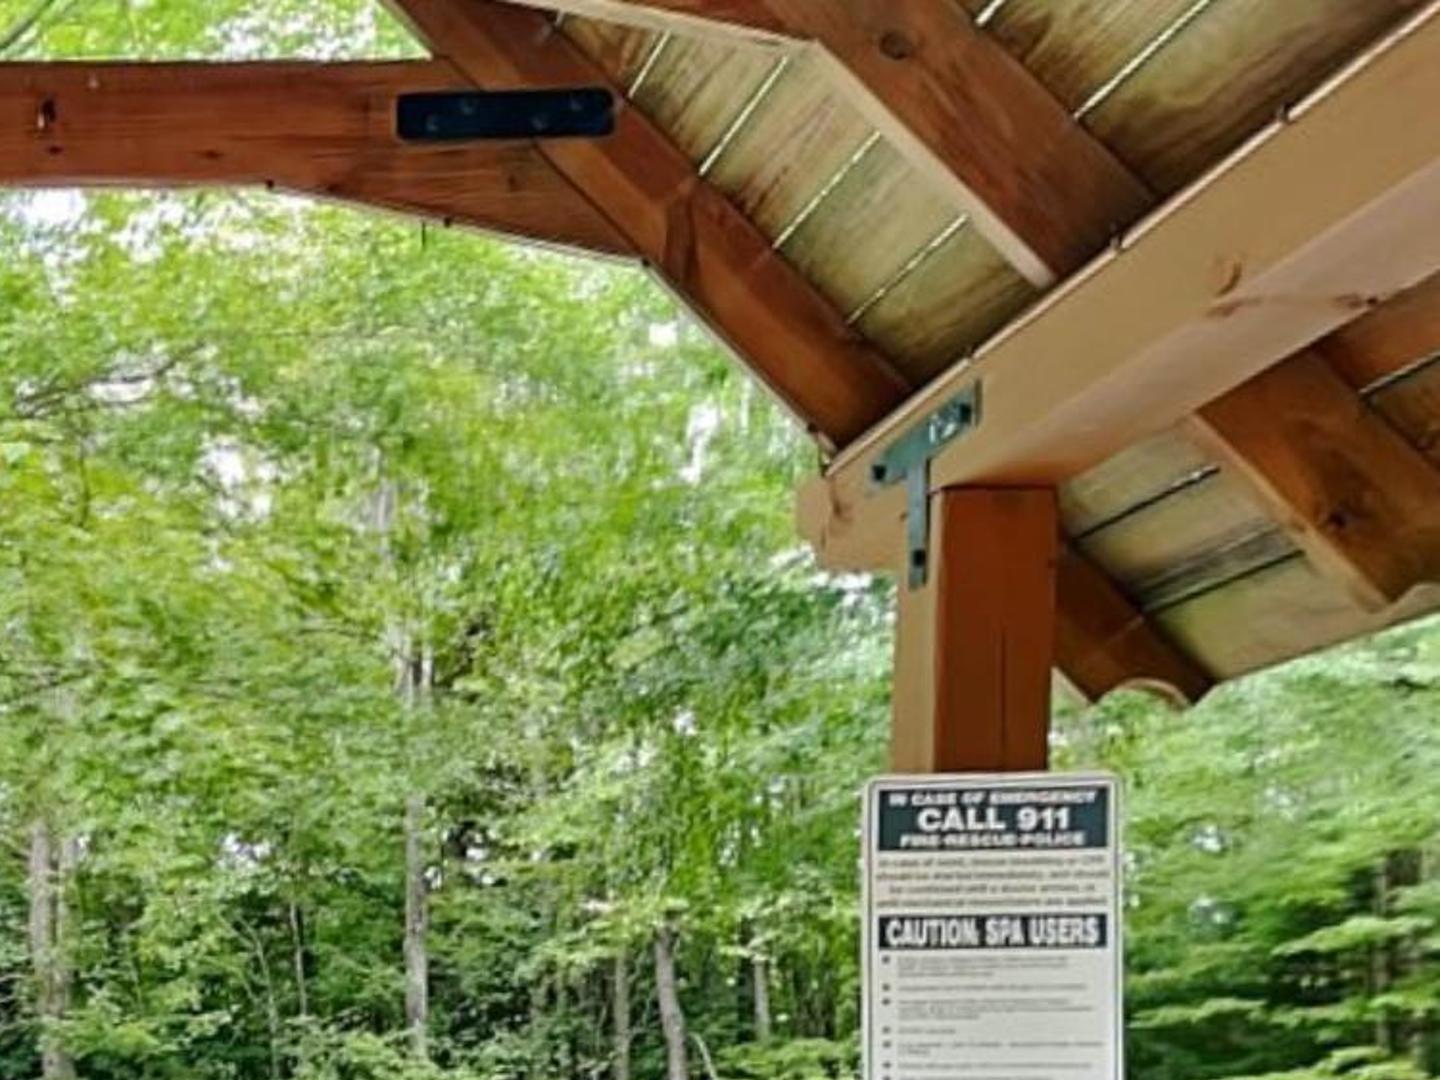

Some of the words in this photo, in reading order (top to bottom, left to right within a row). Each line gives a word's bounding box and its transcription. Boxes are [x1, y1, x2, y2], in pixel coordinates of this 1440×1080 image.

[917, 806, 1006, 832] CALL
[1018, 806, 1069, 832] 911
[885, 918, 979, 947] CAUTION
[985, 917, 1025, 946] SPA
[1029, 916, 1100, 945] USERS
